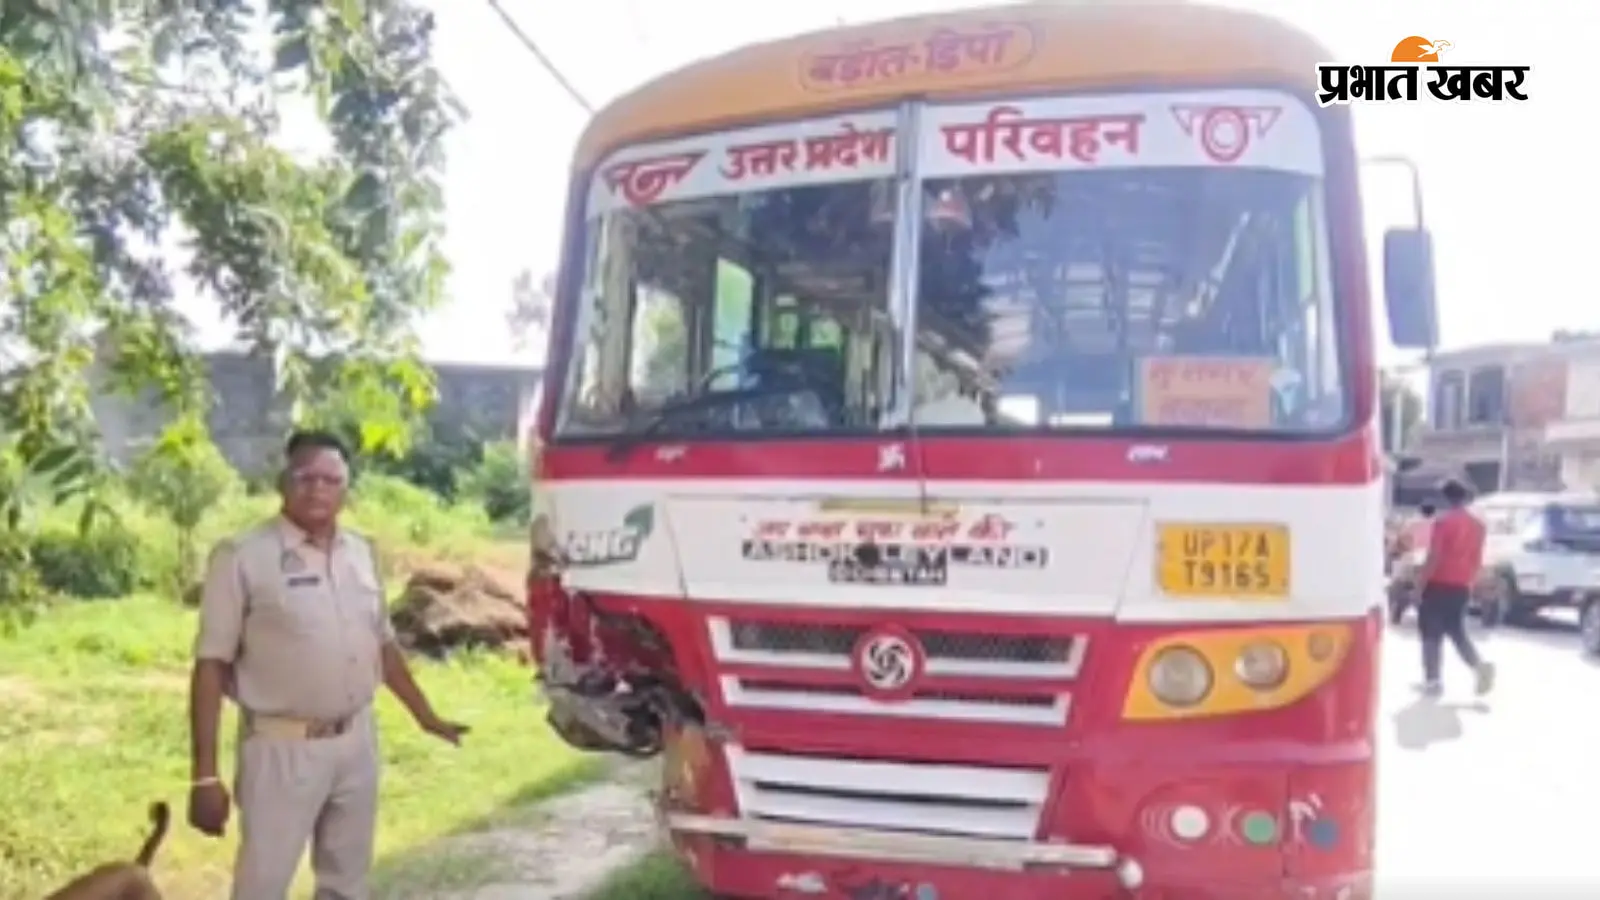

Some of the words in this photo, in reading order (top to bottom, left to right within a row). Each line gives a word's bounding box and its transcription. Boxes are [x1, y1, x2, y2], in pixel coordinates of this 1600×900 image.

[717, 142, 798, 181] उत्तर
[803, 124, 896, 172] प्रदेश
[940, 106, 1146, 164] परिवहन
